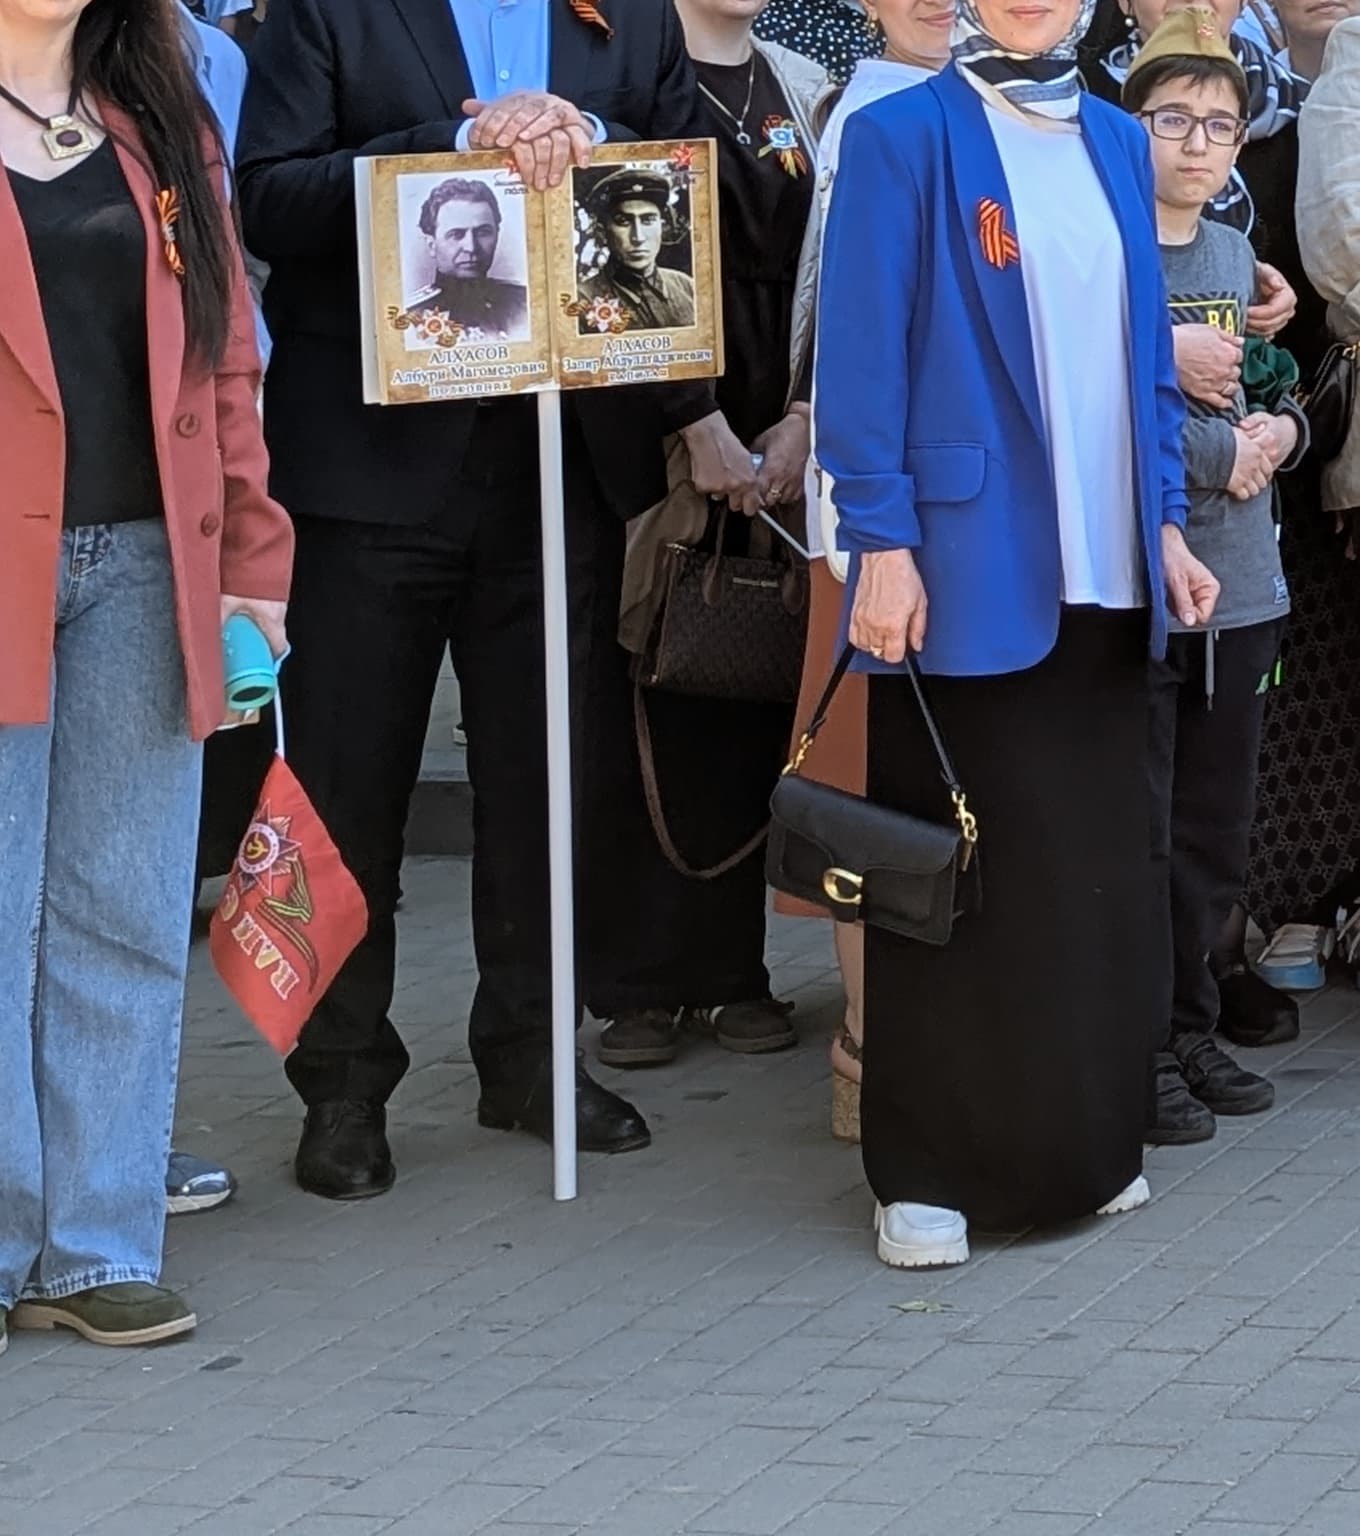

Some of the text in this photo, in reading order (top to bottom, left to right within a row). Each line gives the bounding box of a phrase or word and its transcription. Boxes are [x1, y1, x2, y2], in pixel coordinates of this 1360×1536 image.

[604, 336, 671, 353] АЛХАСОВ
[430, 346, 508, 364] АЛХАСОВ
[564, 358, 599, 372] Запир
[393, 363, 545, 385] Албури Магомедович
